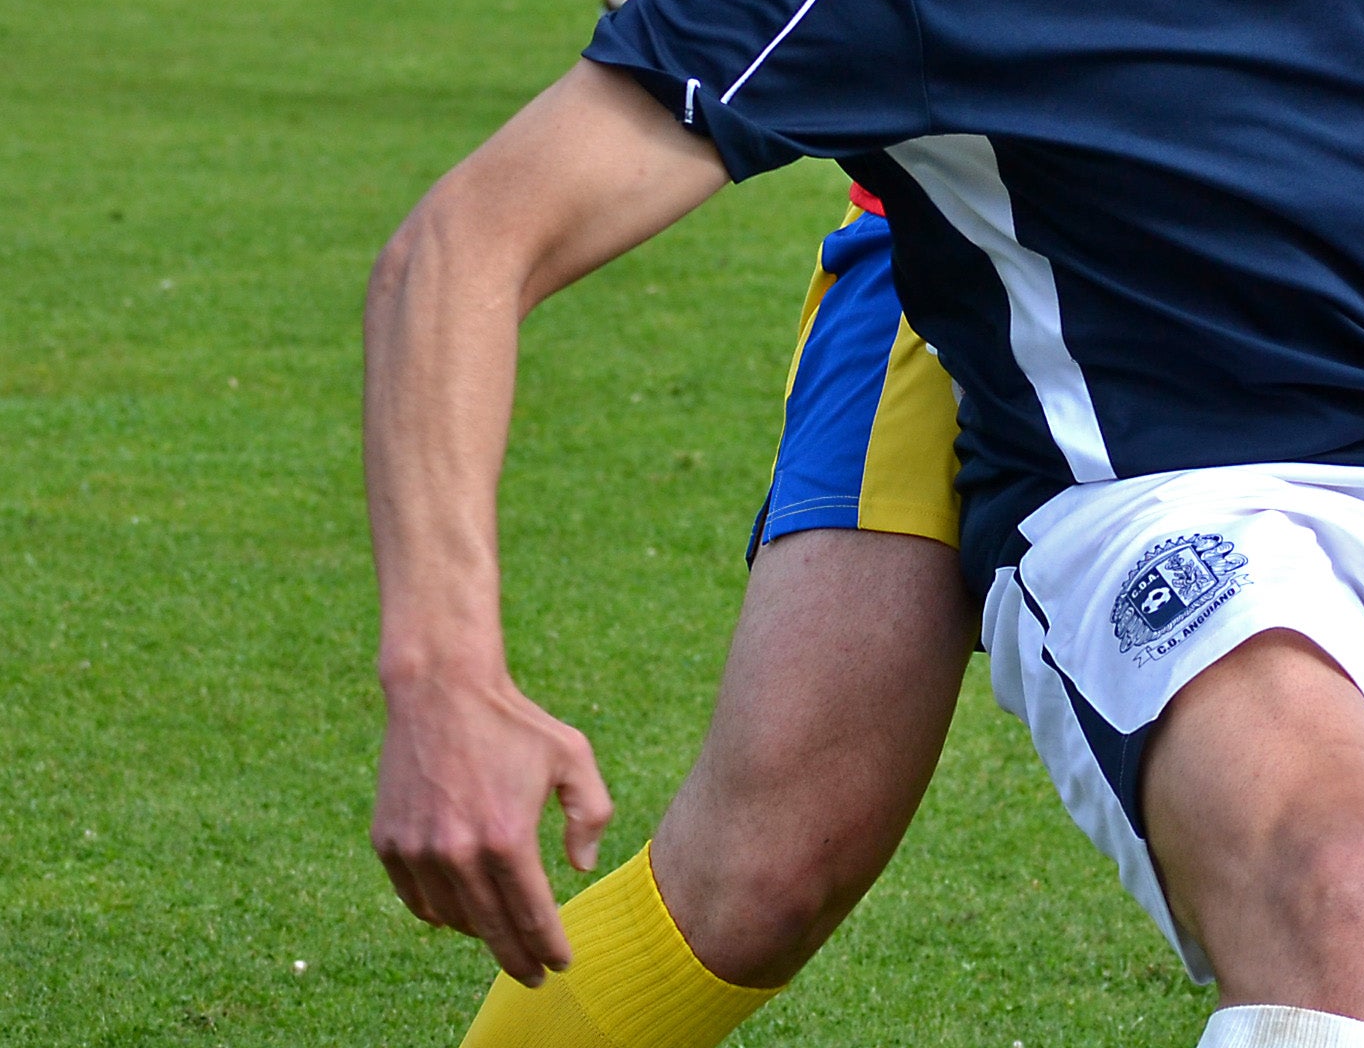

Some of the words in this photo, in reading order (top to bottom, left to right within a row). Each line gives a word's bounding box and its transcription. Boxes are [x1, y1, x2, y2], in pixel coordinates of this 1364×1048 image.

[1131, 573, 1160, 599] C.D.A.
[1157, 637, 1181, 655] C.D.
[1182, 588, 1236, 638] ANGUIANO
